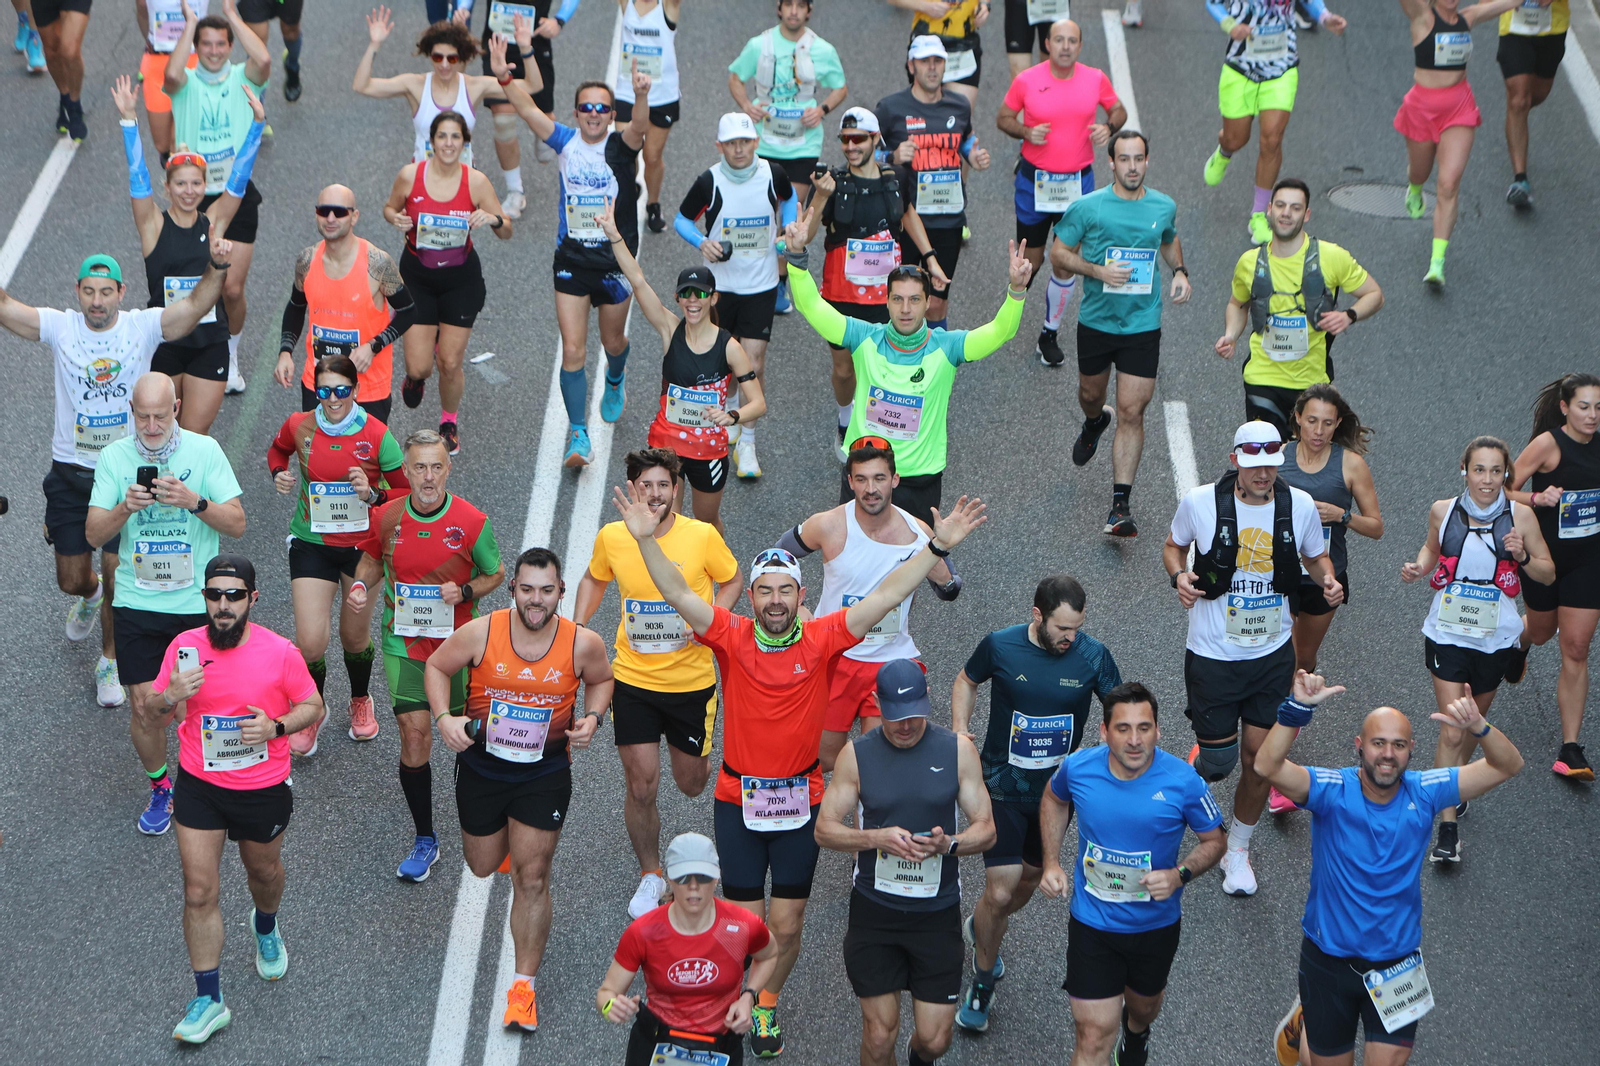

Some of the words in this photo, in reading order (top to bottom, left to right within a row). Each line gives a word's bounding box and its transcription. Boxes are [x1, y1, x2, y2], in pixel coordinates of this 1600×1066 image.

[935, 174, 956, 182] ZURICH
[436, 218, 463, 227] ZURICH
[740, 218, 765, 226] ZURICH
[1275, 317, 1300, 326] ZURICH
[326, 332, 352, 340] ZURICH
[325, 346, 341, 354] 3100
[684, 392, 712, 401] ZURICH
[886, 394, 916, 405] ZURICH
[682, 408, 699, 416] 9396
[884, 410, 902, 419] 7332
[92, 417, 122, 425] ZURICH
[678, 418, 701, 426] NATALIA
[878, 417, 899, 428] RICHAR
[329, 485, 353, 494] ZURIC
[1580, 492, 1600, 500] ZURIC
[330, 502, 348, 510] 9110
[1577, 516, 1597, 526] JAVIER
[140, 529, 187, 537] SEVILLA'24
[152, 544, 185, 552] ZURICH
[1249, 580, 1263, 594] TO
[413, 589, 440, 597] ZURIC
[1463, 588, 1494, 599] ZURICH
[1247, 597, 1276, 608] ZURICH
[413, 607, 432, 615] 8929
[1461, 605, 1480, 614] 9552
[1244, 616, 1266, 625] 10192
[1458, 616, 1479, 625] SONIA
[644, 622, 664, 630] 9036
[511, 709, 546, 720] ZURICH
[1031, 720, 1065, 729] ZURICH
[509, 728, 529, 738] 7287
[493, 737, 539, 749] JULIHOOLIGAN
[1028, 738, 1052, 746] 13035
[216, 747, 254, 758] ABROHUGA
[765, 779, 800, 788] ZURICH
[766, 797, 786, 805] 7078
[754, 808, 800, 817] AYLA-AITANA
[1106, 853, 1142, 866] ZURICH
[897, 860, 922, 870] 10311
[893, 874, 924, 882] JORDAN
[1105, 871, 1126, 880] 9032
[1384, 954, 1418, 978] ZURICH
[681, 1052, 719, 1066] ZURICH
